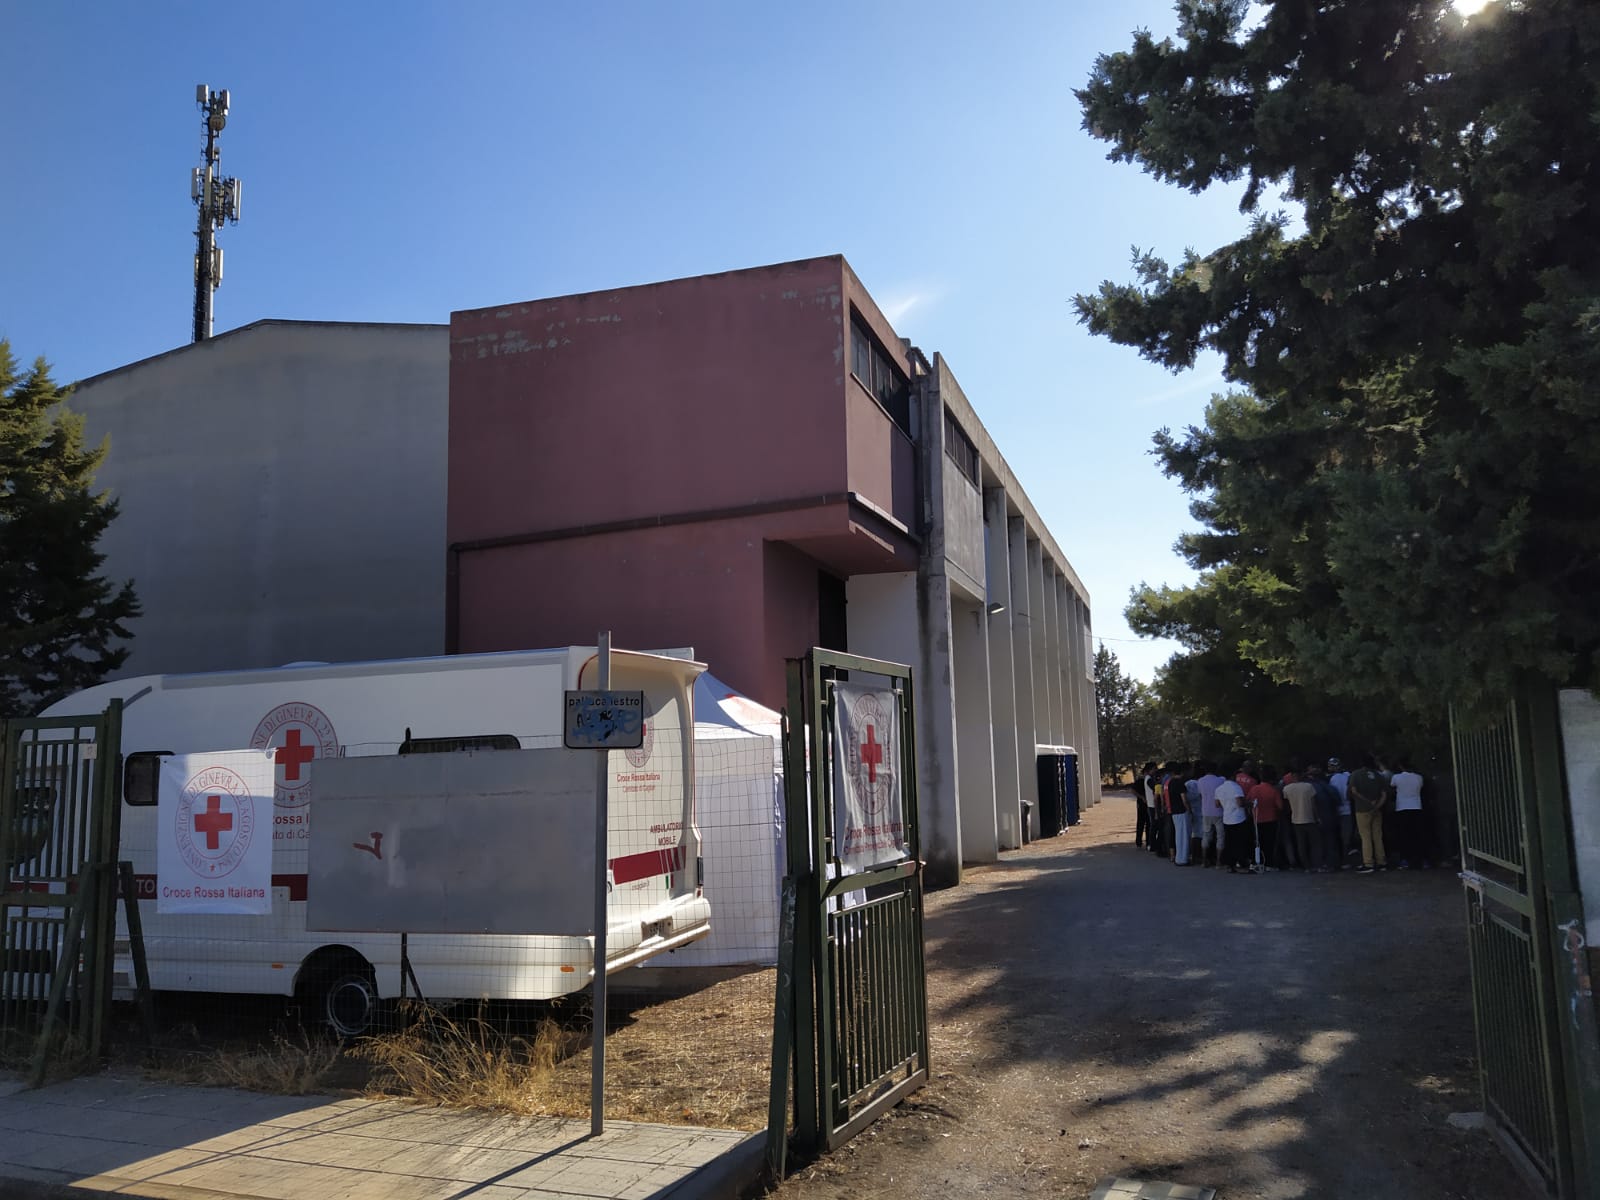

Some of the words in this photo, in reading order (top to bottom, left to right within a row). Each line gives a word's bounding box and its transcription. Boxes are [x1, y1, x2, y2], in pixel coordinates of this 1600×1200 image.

[162, 886, 191, 898] Croce
[194, 886, 225, 898] Rossa
[227, 886, 265, 898] Italiana
